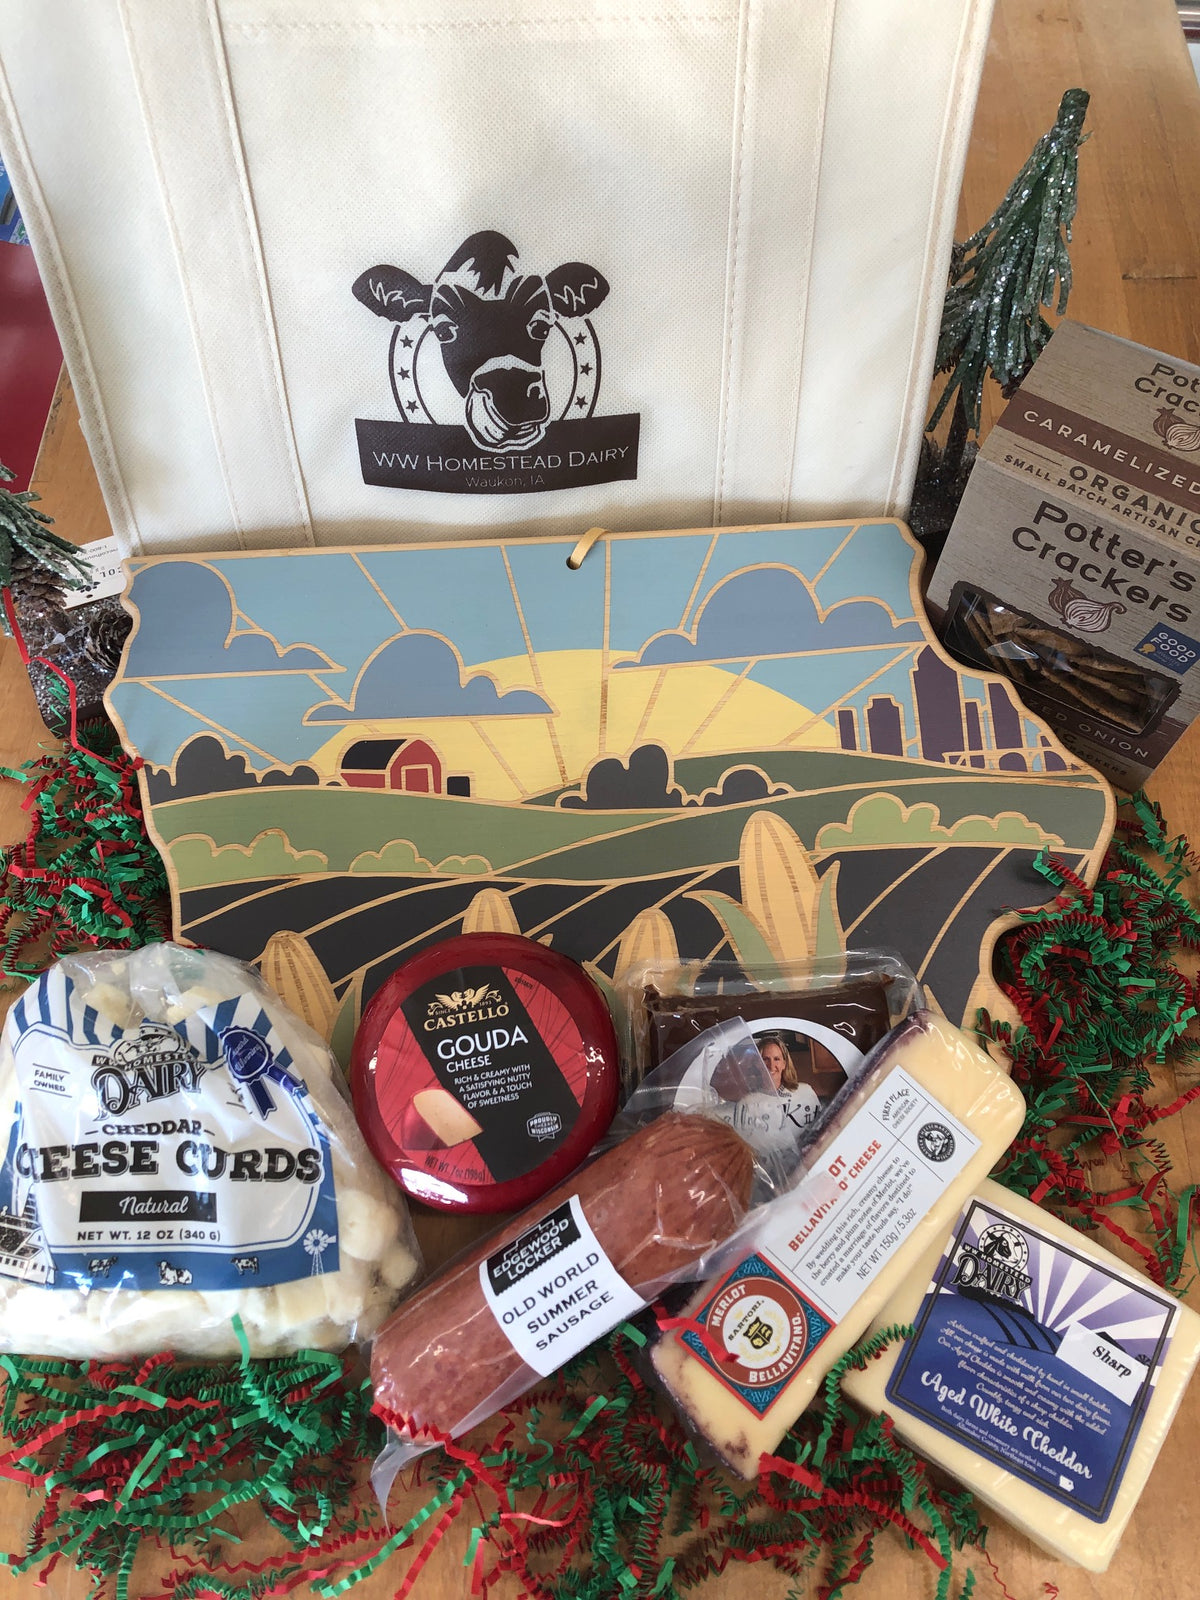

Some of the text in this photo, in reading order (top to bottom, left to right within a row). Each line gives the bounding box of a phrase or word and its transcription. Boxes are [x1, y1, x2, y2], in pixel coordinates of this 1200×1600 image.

[372, 446, 630, 472] WW HOMESTEAD DAIRY
[1024, 410, 1200, 494] CARAMELIZED
[466, 476, 545, 488] Waukon, IA
[1004, 454, 1180, 538] SMALL BATCH ARTISAN
[1070, 466, 1200, 534] ORGANIC
[1033, 500, 1198, 592] Potter's
[1012, 526, 1192, 623] Crackers
[1150, 637, 1188, 662] FOOD
[1158, 632, 1196, 658] GOOD
[1078, 724, 1148, 758] ONION
[424, 1004, 509, 1032] CASTELLO
[437, 1025, 528, 1059] GOUDA
[34, 1070, 66, 1083] FAMILY
[447, 1054, 491, 1073] CHEESE
[454, 1075, 472, 1084] RICH
[480, 1068, 510, 1079] CREAMY
[511, 1063, 530, 1072] WITH
[465, 1077, 506, 1091] SATISFYING
[507, 1072, 531, 1082] NUTTY
[33, 1080, 66, 1092] OWNED
[91, 1060, 207, 1121] DAIRY
[462, 1090, 490, 1100] FLAVOR
[506, 1081, 532, 1091] TOUCH
[478, 1092, 519, 1106] SWEETNESS
[882, 1088, 910, 1120] FIRST PLACE
[102, 1119, 202, 1136] CHEDDAR
[176, 1140, 322, 1184] CURDS
[848, 1139, 881, 1178] CHEESE
[120, 1196, 188, 1216] Natural
[806, 1155, 900, 1270] By wedding this rich, creamy cheese to
[811, 1159, 910, 1280] the berry and plum notes of Merlot, we've
[77, 1230, 221, 1242] NET WT. 12 OZ (340 G)
[819, 1261, 840, 1286] created
[842, 1229, 868, 1258] marriage
[864, 1220, 873, 1230] of
[870, 1200, 889, 1222] flavors
[887, 1174, 910, 1202] destined
[908, 1167, 916, 1176] to
[835, 1263, 851, 1282] make
[849, 1249, 864, 1266] your
[861, 1232, 876, 1249] taste
[874, 1216, 888, 1233] buds
[887, 1205, 899, 1219] say,
[856, 1207, 916, 1279] NET WT 150g / 5.3oz
[493, 1219, 569, 1278] EDGEWOOD
[508, 1237, 562, 1280] LOCKER
[964, 1244, 1031, 1283] WW HOMESTEAD
[502, 1252, 599, 1324] OLD WORLD
[950, 1252, 1031, 1302] DAIRY
[527, 1279, 598, 1333] SUMMER
[536, 1291, 614, 1350] SAUSAGE
[712, 1284, 746, 1326] MERLOT
[970, 1331, 994, 1349] crafted
[993, 1344, 1006, 1354] and
[1036, 1368, 1047, 1378] by
[1046, 1372, 1064, 1386] hand
[1070, 1386, 1089, 1400] small
[1093, 1344, 1132, 1379] Sharp
[937, 1335, 952, 1347] Our
[950, 1343, 971, 1359] Aged
[969, 1354, 997, 1373] Cheddar
[1002, 1372, 1025, 1388] smooth
[1023, 1385, 1038, 1396] and
[1035, 1394, 1059, 1411] creamy
[1059, 1405, 1075, 1417] with
[1074, 1413, 1086, 1423] the
[1084, 1419, 1106, 1435] added
[988, 1353, 1006, 1366] made
[1005, 1362, 1021, 1374] with
[1020, 1370, 1036, 1382] milk
[1034, 1378, 1051, 1392] from
[1073, 1401, 1093, 1416] dairy
[921, 1370, 1092, 1480] Aged White Cheddar
[1002, 1399, 1023, 1414] tangy
[1022, 1408, 1036, 1420] and
[1016, 1394, 1026, 1403] of
[1029, 1401, 1049, 1416] sharp
